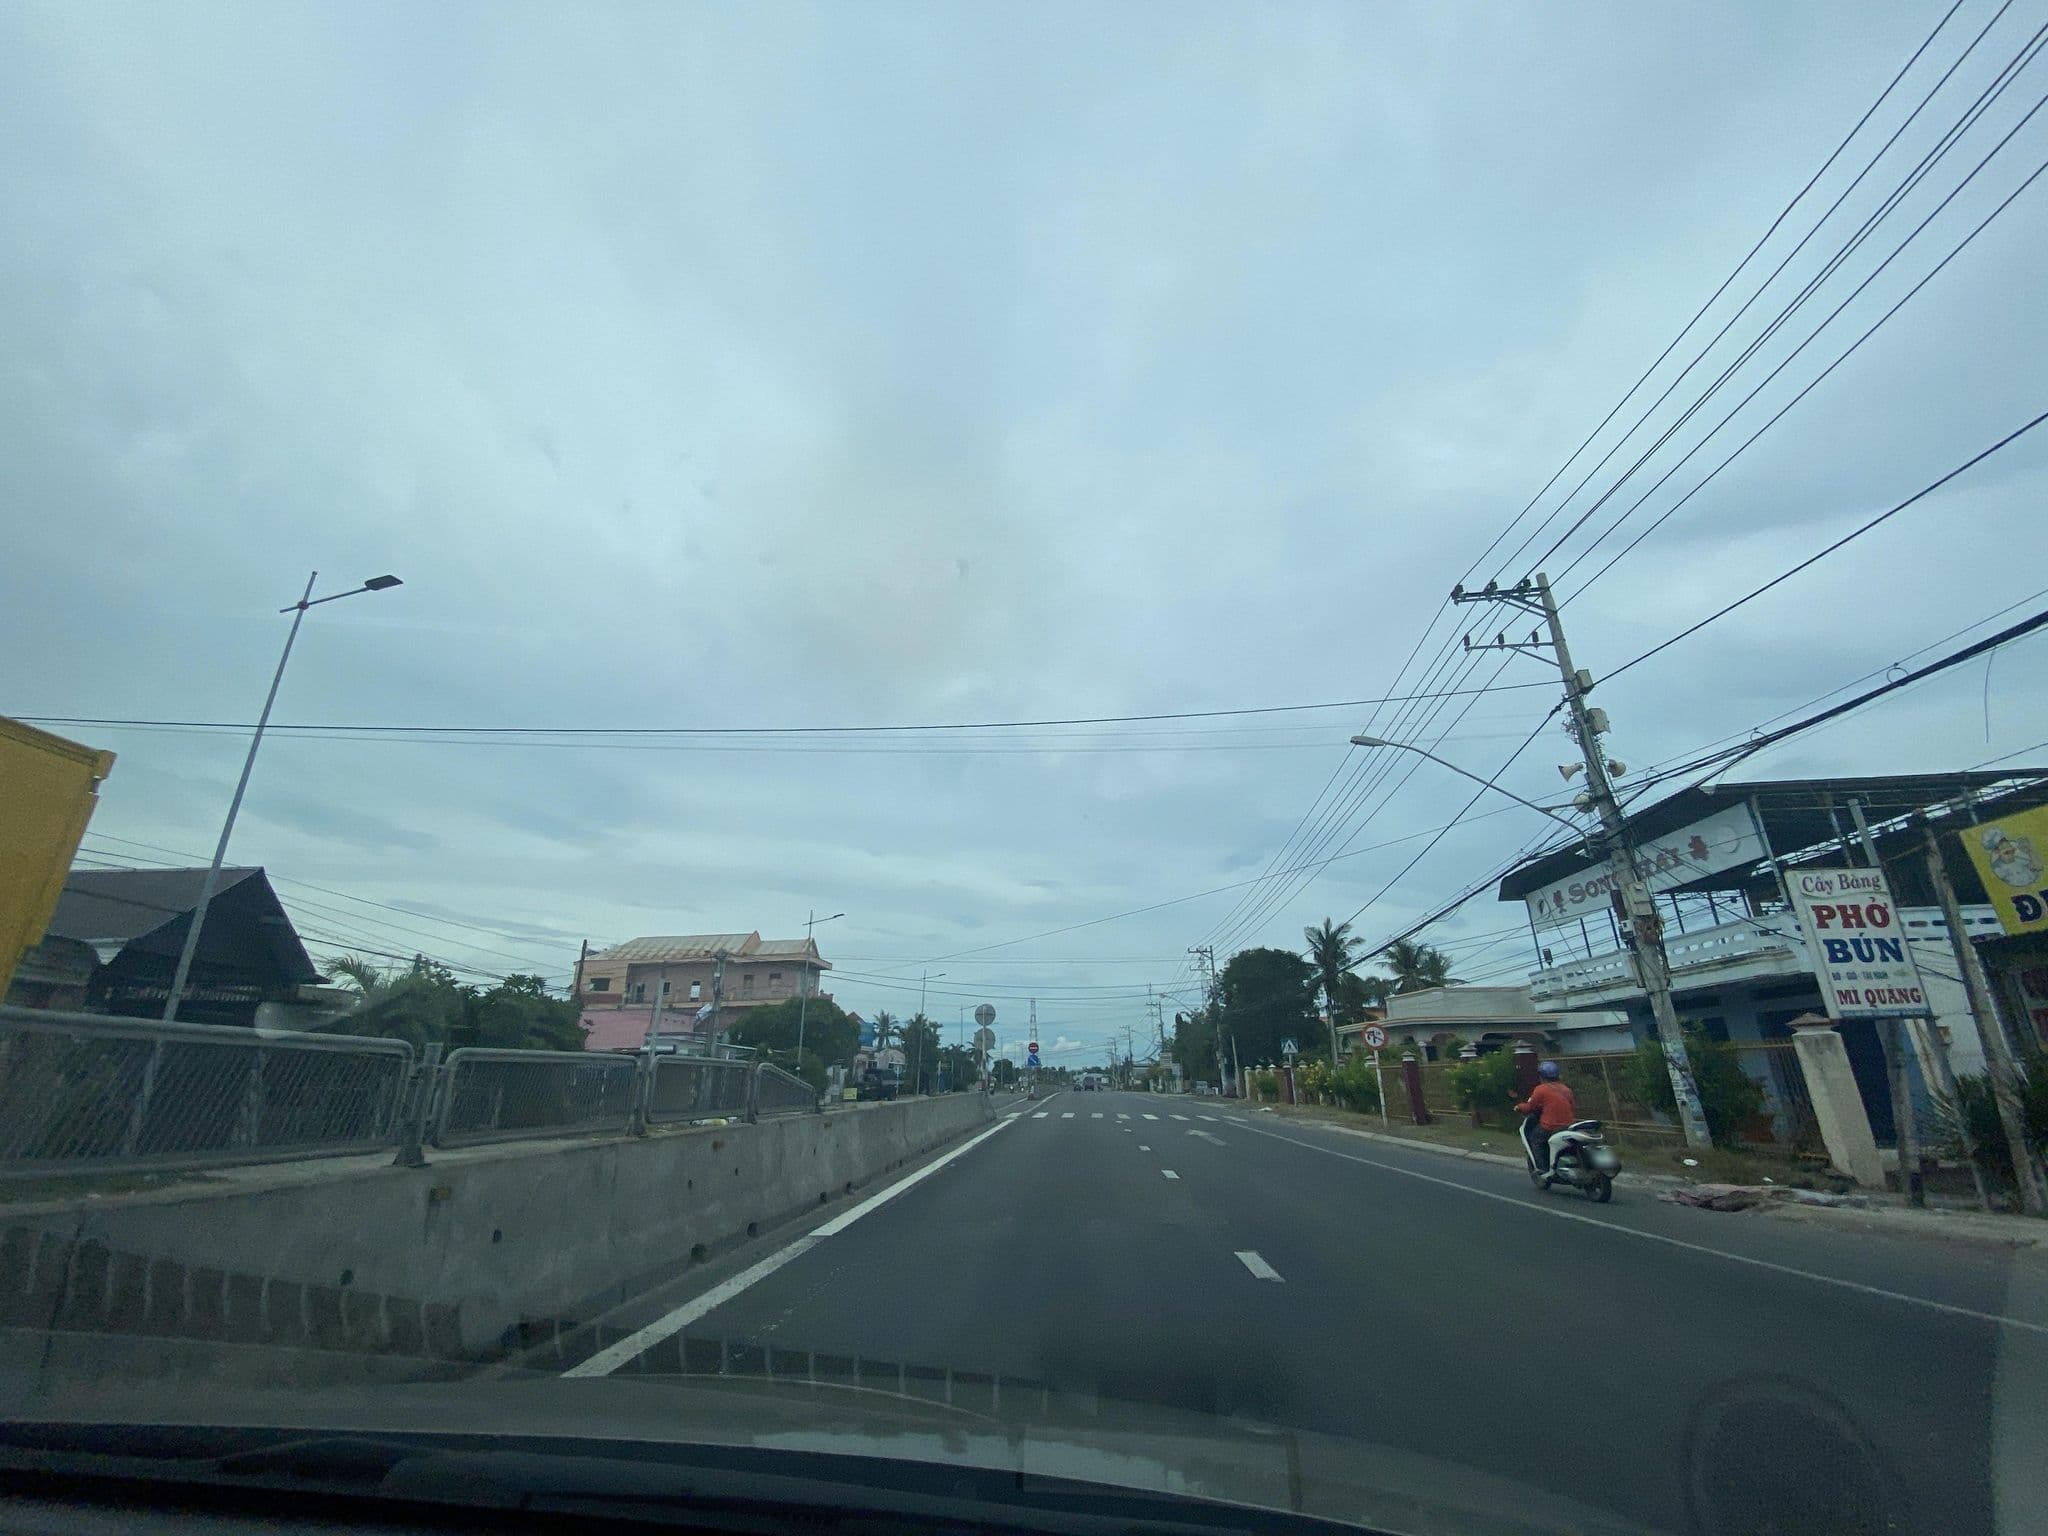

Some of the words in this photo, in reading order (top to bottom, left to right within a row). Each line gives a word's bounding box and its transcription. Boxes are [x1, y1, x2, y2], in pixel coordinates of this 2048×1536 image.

[1802, 876, 1833, 895] Cây
[1810, 896, 1890, 929] PHỞ
[1822, 932, 1904, 964] BÚN
[1864, 983, 1922, 1008] QUẢNG
